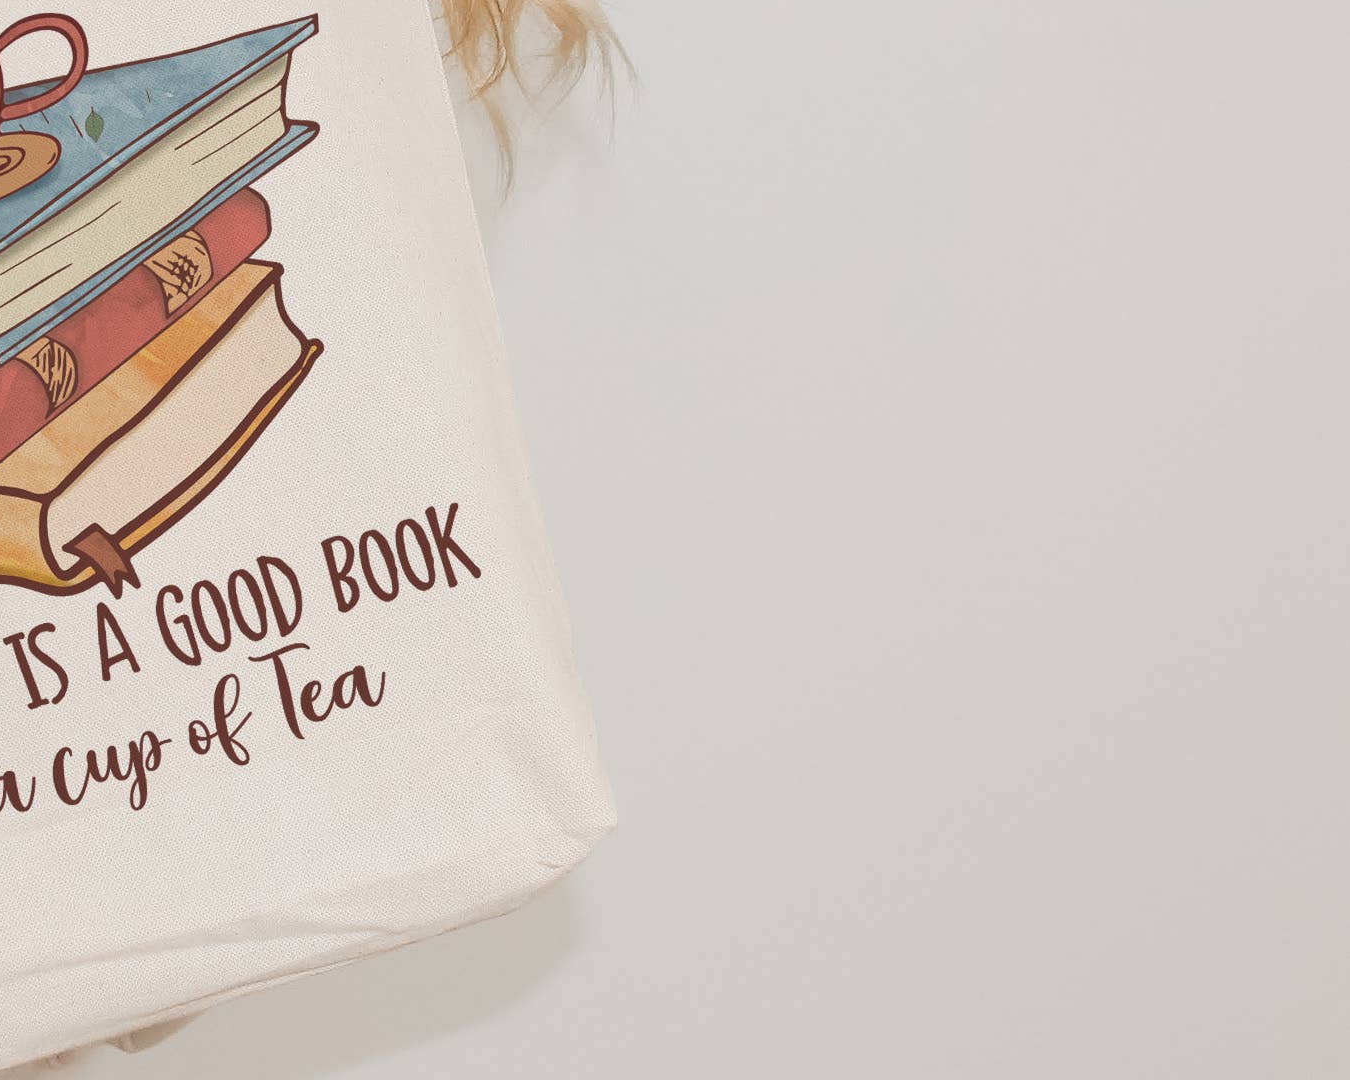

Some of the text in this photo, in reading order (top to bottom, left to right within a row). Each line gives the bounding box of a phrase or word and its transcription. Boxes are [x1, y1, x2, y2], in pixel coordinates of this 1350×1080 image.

[3, 623, 68, 709] IS
[97, 602, 140, 681] A
[156, 556, 302, 666] GOOD
[321, 503, 481, 613] BOOK
[189, 674, 252, 765] of
[248, 643, 385, 739] Tea
